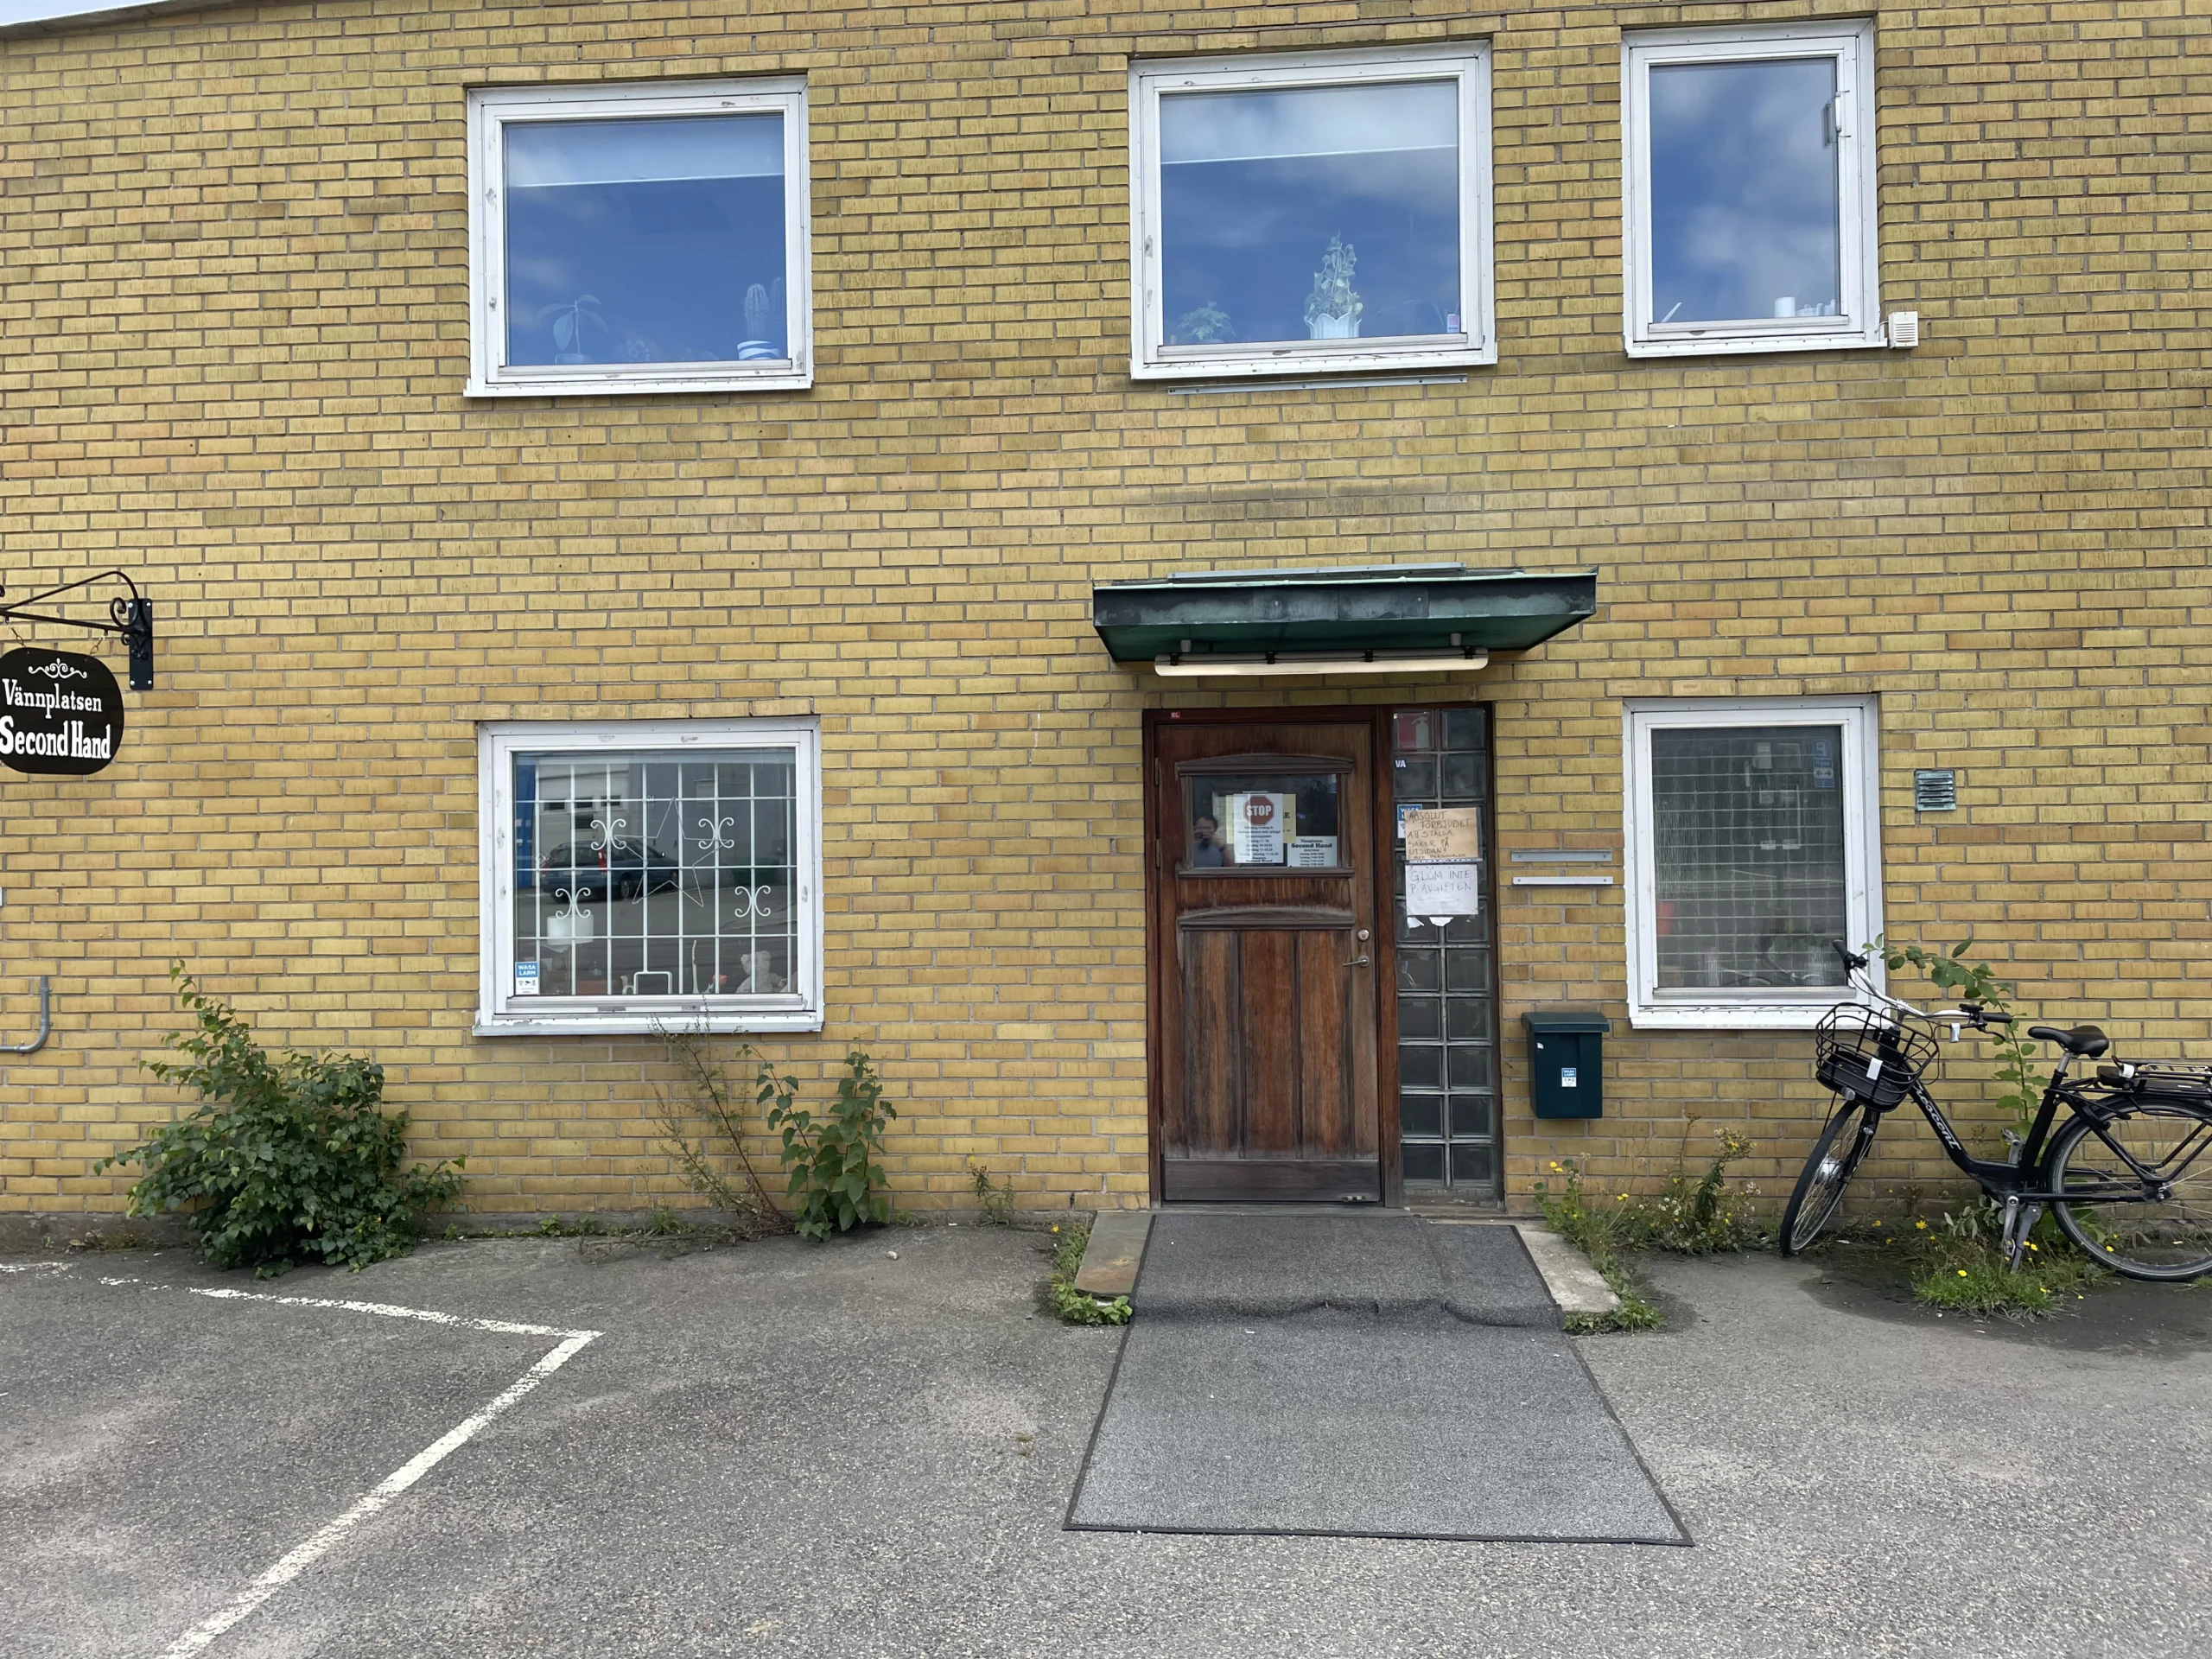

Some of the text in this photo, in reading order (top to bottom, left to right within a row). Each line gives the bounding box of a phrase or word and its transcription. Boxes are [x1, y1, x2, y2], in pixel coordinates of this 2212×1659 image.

[2, 678, 102, 719] Vännplatsen
[0, 715, 111, 759] Second Hand
[1395, 760, 1407, 768] VA
[1246, 805, 1272, 816] STOP
[1409, 810, 1448, 823] ABSOLUT
